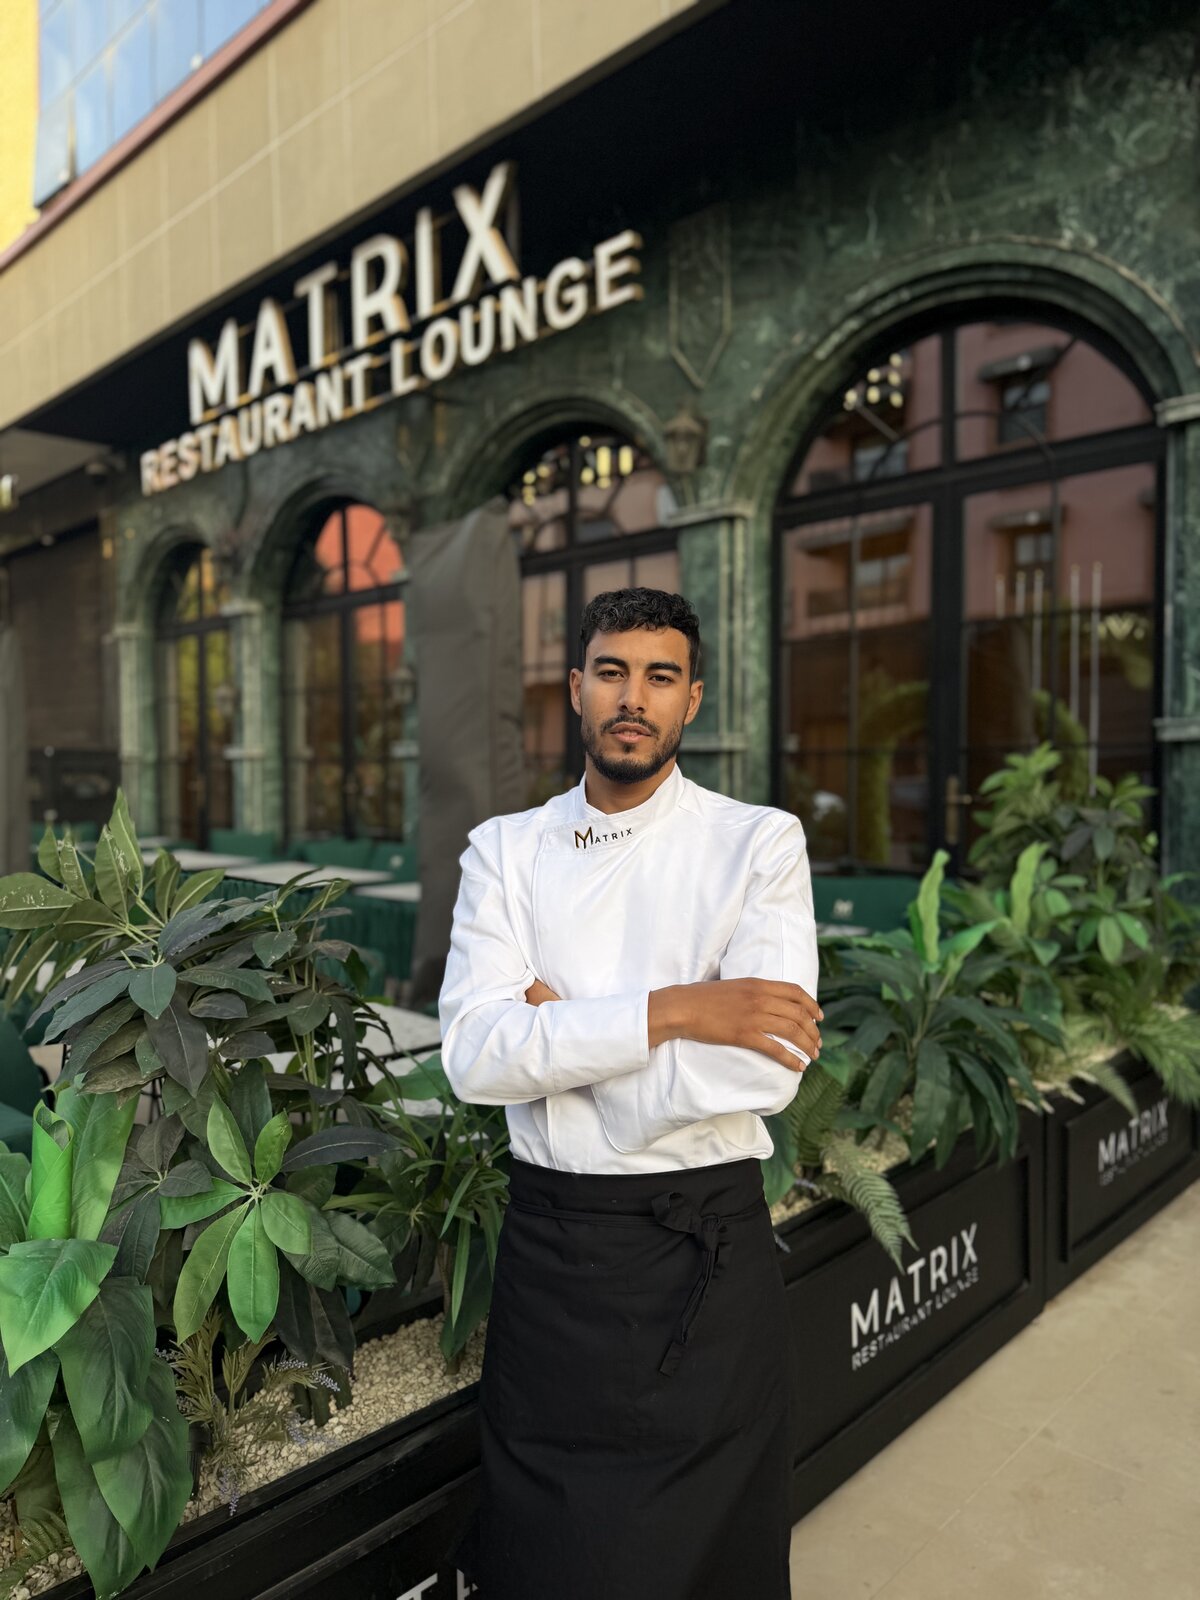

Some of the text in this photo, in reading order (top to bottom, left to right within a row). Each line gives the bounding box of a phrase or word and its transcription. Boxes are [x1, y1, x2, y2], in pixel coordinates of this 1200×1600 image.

[188, 161, 519, 425] MATRIX
[140, 229, 643, 495] RESTAURANT LOUNGE
[1098, 1097, 1168, 1173] MATRIX
[851, 1222, 978, 1348] MATRIX
[851, 1299, 933, 1371] RESTAURANT
